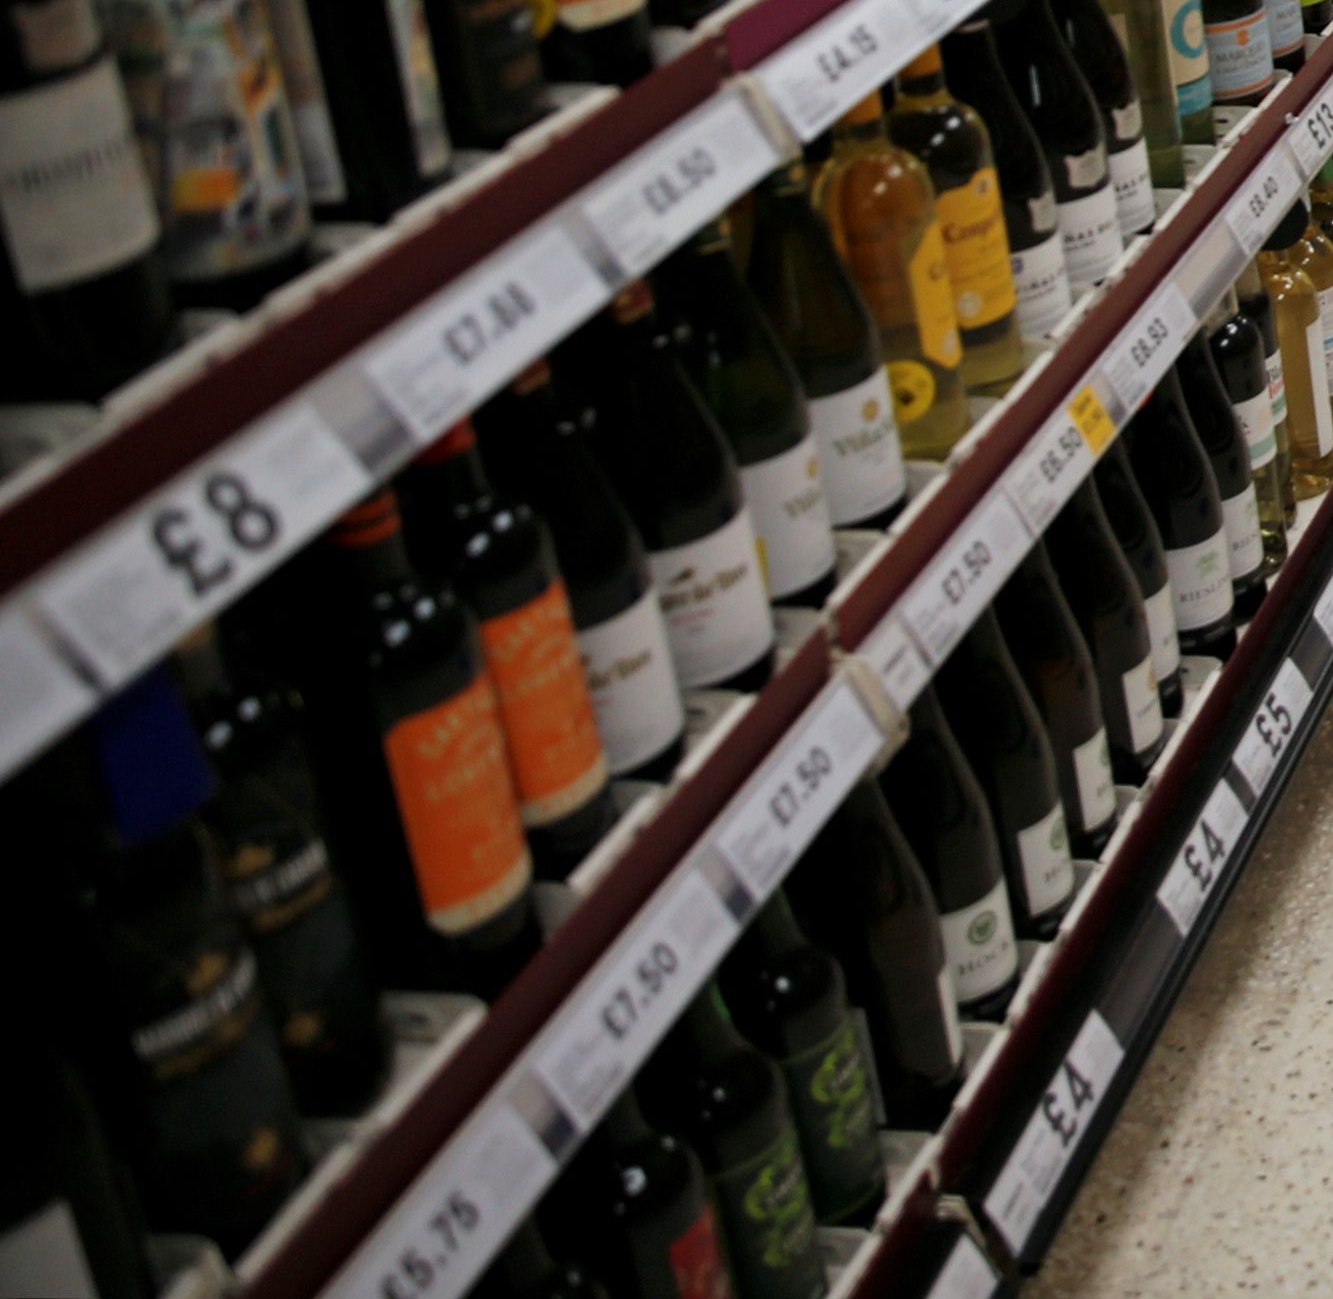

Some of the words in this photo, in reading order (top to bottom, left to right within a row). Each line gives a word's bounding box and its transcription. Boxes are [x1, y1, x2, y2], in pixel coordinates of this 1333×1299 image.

[150, 471, 280, 596] £8
[941, 539, 993, 605] £7.50
[1255, 691, 1293, 759] £5
[767, 744, 832, 827] £7.50
[1184, 823, 1227, 892] £4
[602, 943, 679, 1042] £7.50
[1043, 1075, 1095, 1144] £4
